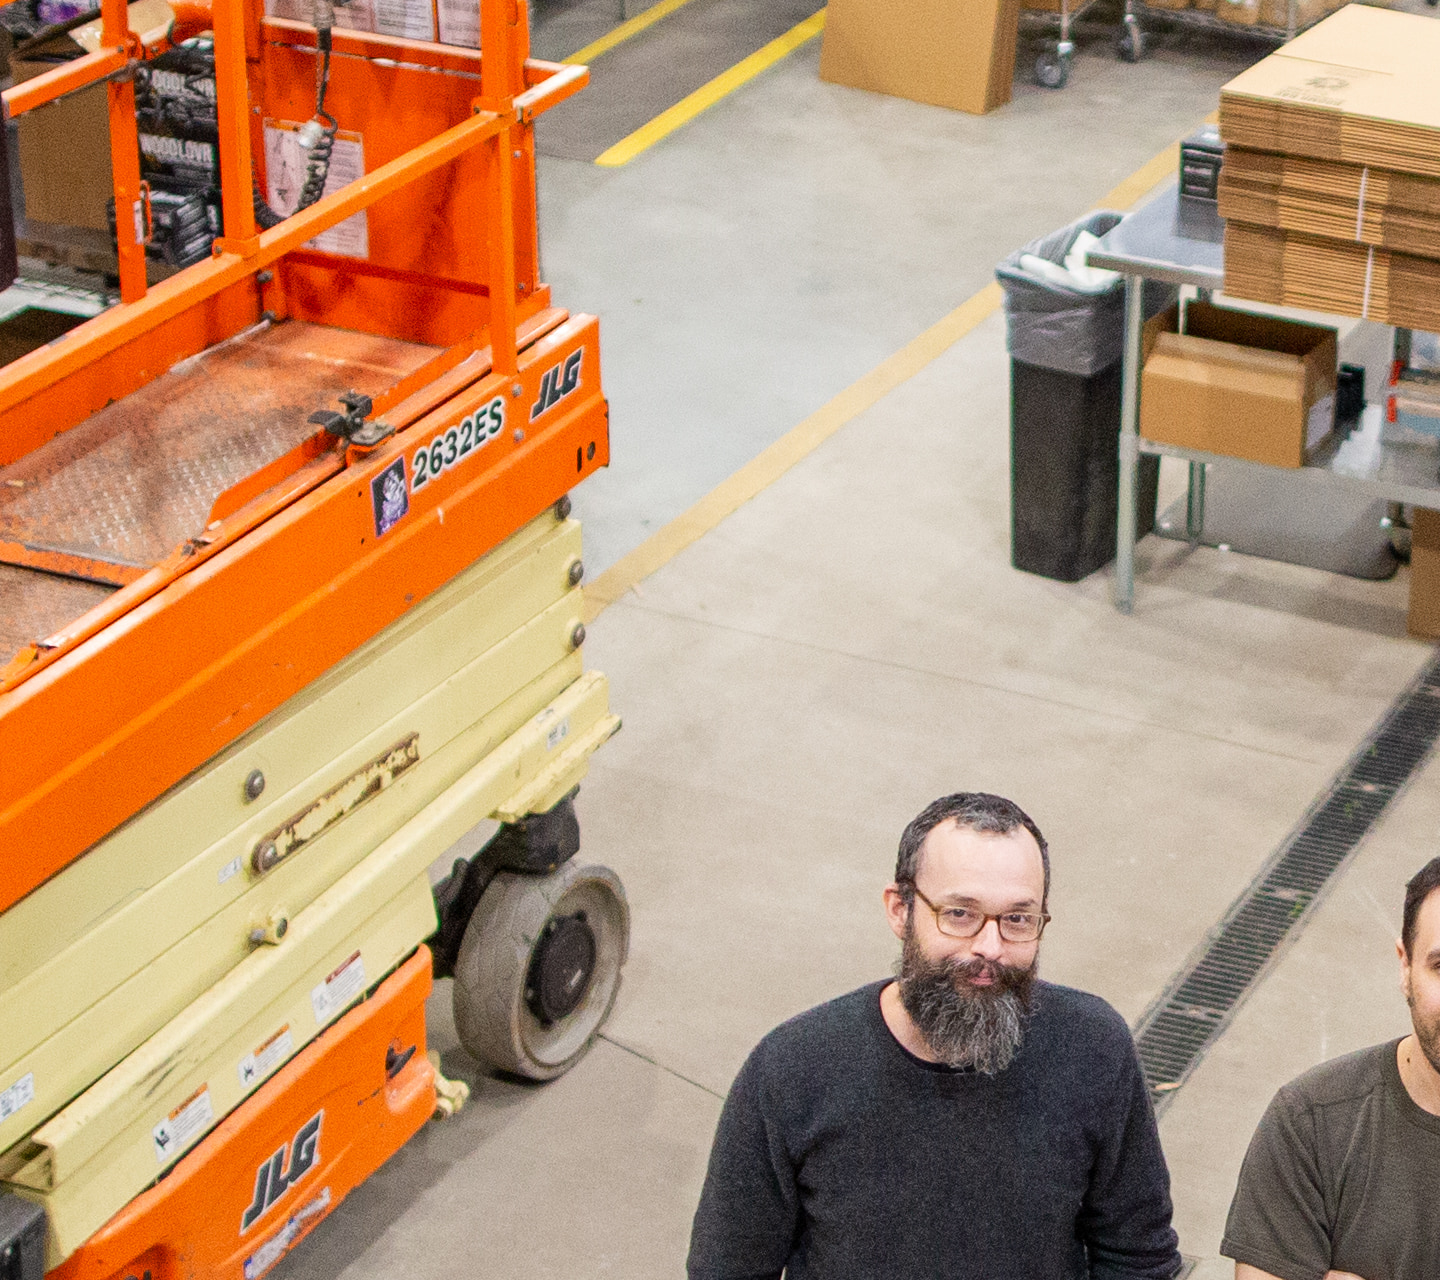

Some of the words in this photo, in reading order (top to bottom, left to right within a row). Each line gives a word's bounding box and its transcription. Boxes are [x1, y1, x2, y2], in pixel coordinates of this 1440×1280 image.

[531, 346, 583, 421] JLG
[412, 399, 503, 489] 2632ES
[240, 1108, 324, 1235] JLG
